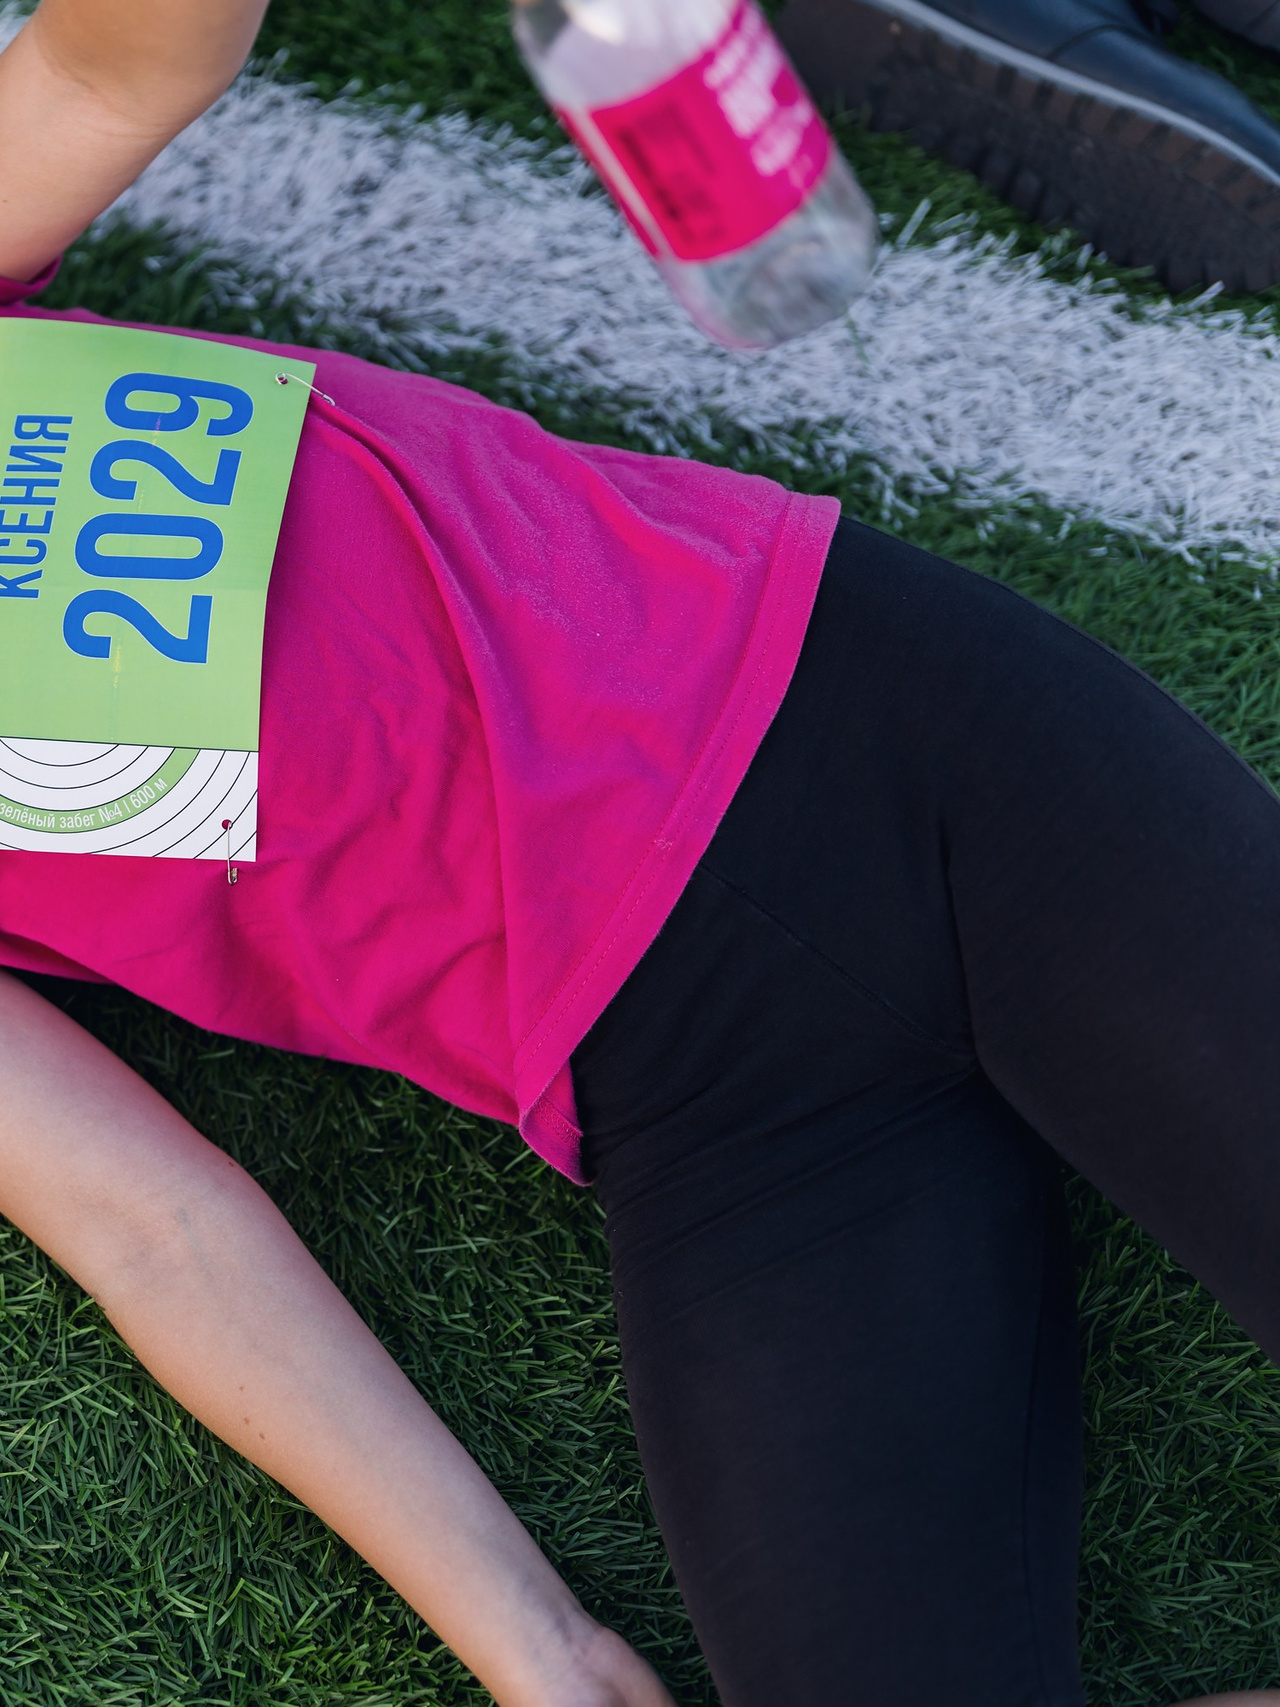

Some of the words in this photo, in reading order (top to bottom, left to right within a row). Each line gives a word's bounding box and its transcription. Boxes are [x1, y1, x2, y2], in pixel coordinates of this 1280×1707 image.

[62, 372, 254, 664] 2029
[59, 813, 96, 829] забег
[98, 807, 123, 824] №4
[130, 785, 156, 809] 600
